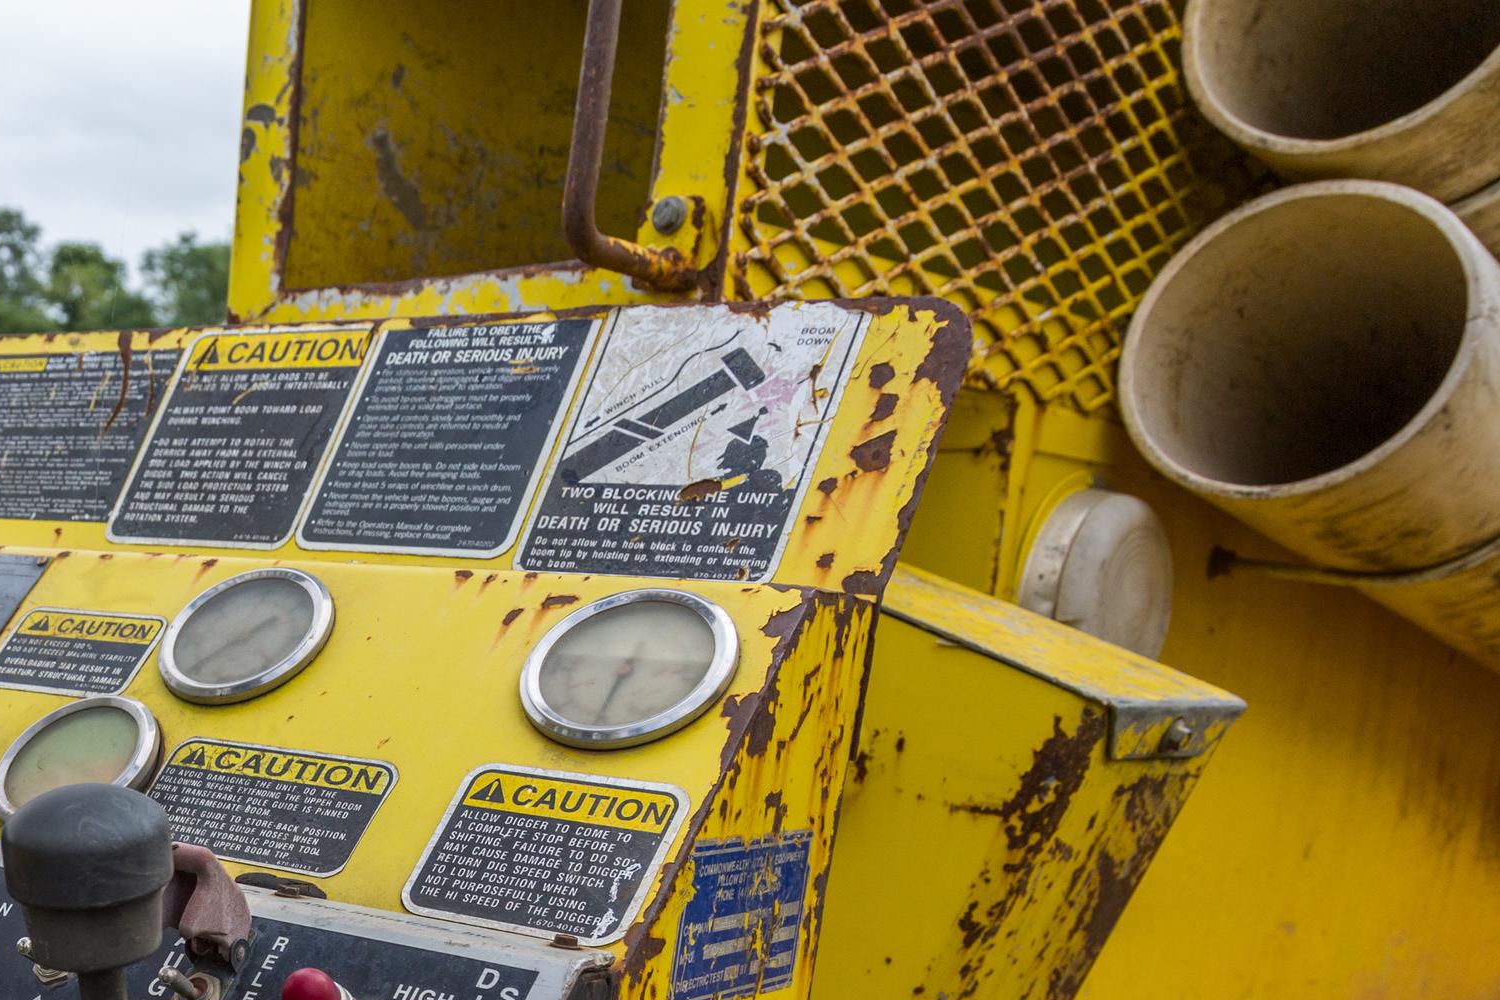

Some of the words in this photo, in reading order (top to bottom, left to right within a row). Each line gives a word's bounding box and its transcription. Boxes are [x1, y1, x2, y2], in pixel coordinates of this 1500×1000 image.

[408, 337, 469, 348] FOLLOWING
[471, 336, 494, 346] WILL
[498, 335, 539, 345] RESULT
[541, 334, 554, 344] IN
[427, 327, 469, 337] FAILURE
[472, 326, 486, 336] TO
[488, 325, 519, 335] OBEY
[522, 324, 542, 334] THE
[796, 338, 832, 346] DOWN
[227, 338, 361, 364] CAUTION
[385, 351, 429, 364] DEATH
[431, 350, 451, 363] OR
[453, 348, 513, 362] SERIOUS
[514, 347, 568, 361] INJURY
[605, 392, 637, 414] WINCH
[641, 376, 665, 392] PULL
[615, 452, 644, 472] BOOM
[648, 416, 706, 452] EXTENDING
[561, 486, 595, 498] TWO
[700, 491, 728, 502] HE
[737, 492, 778, 505] UNIT
[593, 502, 628, 514] WILL
[637, 504, 704, 517] RESULT
[710, 506, 729, 518] IN
[536, 515, 589, 530] DEATH
[597, 517, 620, 531] OR
[628, 518, 702, 535] SERIOUS
[710, 522, 777, 537] INJURY
[534, 535, 547, 544] Do
[551, 537, 567, 545] not
[571, 537, 597, 546] allow
[601, 539, 617, 548] the
[621, 540, 645, 549] hook
[649, 541, 676, 550] block
[681, 542, 691, 551] to
[696, 544, 734, 553] contact
[738, 545, 755, 554] the
[526, 558, 542, 566] the
[547, 558, 577, 568] boom.
[530, 546, 555, 556] boom
[559, 548, 572, 558] tip
[576, 549, 588, 559] by
[591, 550, 629, 562] hoisting
[654, 554, 702, 565] extending
[722, 557, 767, 569] lowering
[57, 618, 153, 640] CAUTION
[215, 750, 383, 790] CAUTION
[160, 775, 202, 787] FOLLOWING
[206, 781, 234, 792] BEFORE
[236, 786, 281, 798] EXTENDING
[284, 793, 300, 802] THE
[303, 796, 332, 806] UPPER
[334, 801, 362, 810] BOOM
[178, 769, 203, 778] AVOID
[205, 772, 251, 785] DAMAGING
[254, 780, 271, 788] THE
[302, 787, 316, 795] DO
[320, 789, 337, 798] THE
[512, 785, 671, 826] CAUTION
[454, 820, 462, 828] A
[467, 821, 527, 838] COMPLETE
[532, 831, 563, 843] STOP
[568, 837, 616, 852] BEFORE
[460, 809, 500, 822] ALLOW
[504, 815, 548, 830] DIGGER
[554, 823, 569, 833] TO
[575, 826, 610, 839] COME
[616, 832, 632, 842] TO
[436, 852, 482, 867] RETURN
[486, 860, 507, 871] DIG
[442, 841, 467, 852] MAY
[471, 846, 508, 859] CAUSE
[512, 852, 561, 868] DAMAGE
[567, 861, 582, 872] TO
[512, 840, 563, 856] FAILURE
[568, 849, 584, 859] TO
[589, 853, 607, 863] DO
[431, 863, 446, 873] TO
[450, 866, 477, 878] LOW
[480, 871, 536, 889] POSITION
[542, 882, 578, 896] WHEN
[424, 874, 447, 885] NOT
[451, 879, 543, 903] PURPOSEFULLY
[548, 896, 586, 910] USING
[419, 886, 440, 896] THE
[444, 890, 458, 899] HI
[504, 900, 521, 910] OF
[527, 904, 549, 916] THE
[555, 910, 601, 926] DIGGER
